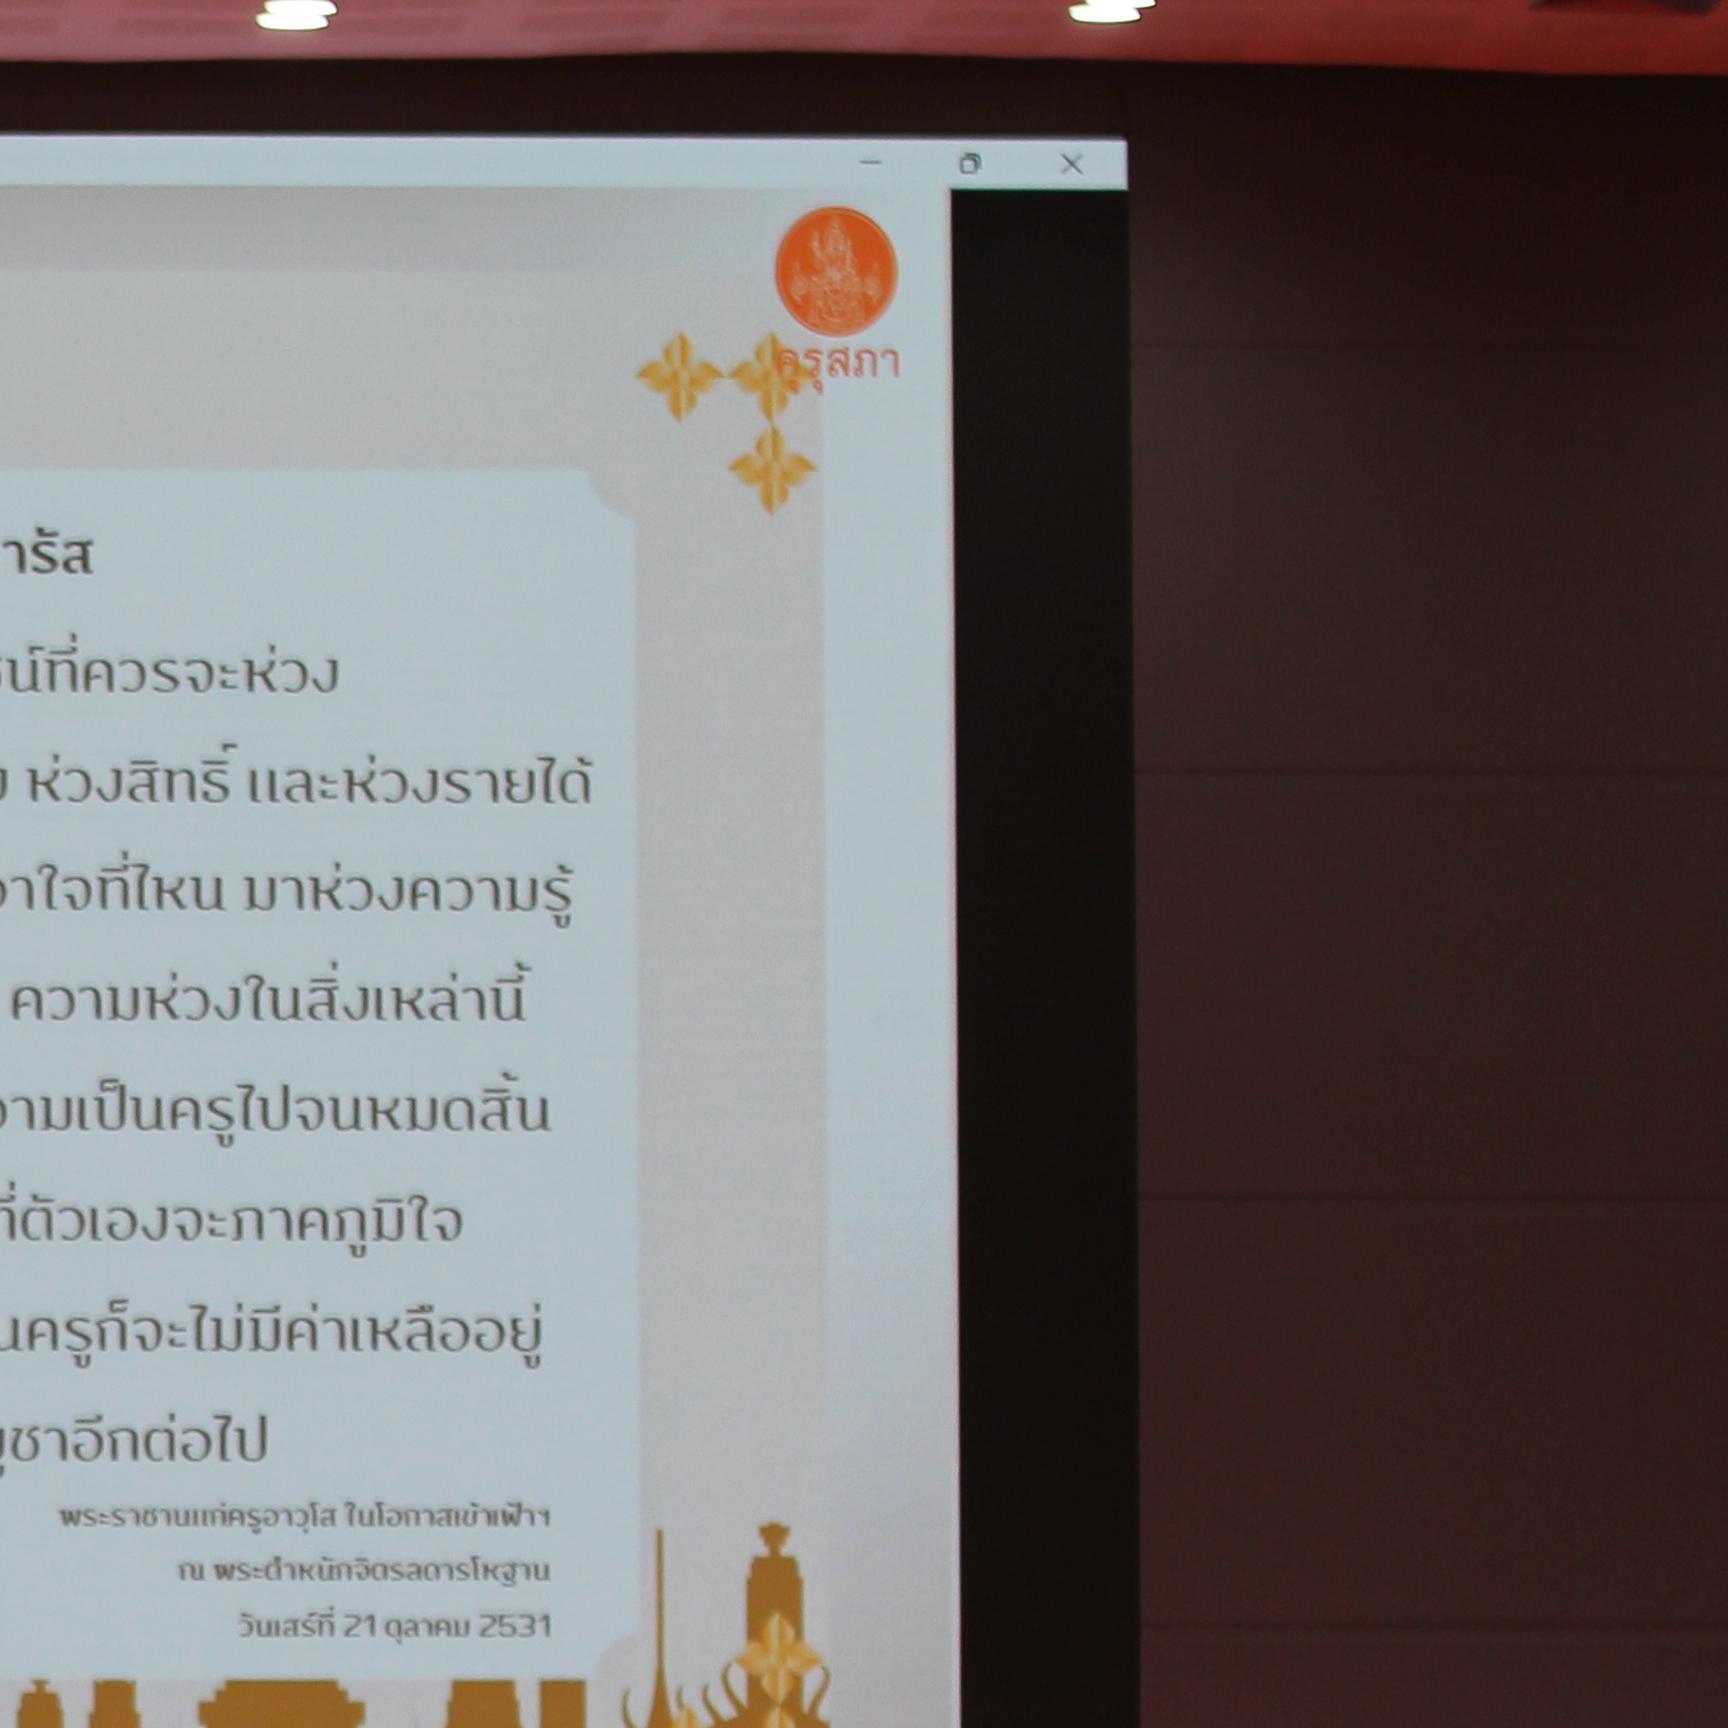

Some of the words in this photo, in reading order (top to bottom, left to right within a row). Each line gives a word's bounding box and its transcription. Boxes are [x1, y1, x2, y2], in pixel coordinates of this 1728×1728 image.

[27, 743, 239, 804] ห่วงสิทธิ์
[248, 754, 595, 805] และห่วงรายได้
[244, 862, 575, 930] มาห่วงความรู้
[12, 961, 533, 1023] ความห่วงในสิ่งเหล่านี้
[178, 1561, 206, 1582] ณ
[343, 1614, 378, 1639] 21
[384, 1618, 472, 1646] ตุลาคม
[479, 1614, 552, 1639] 2531
